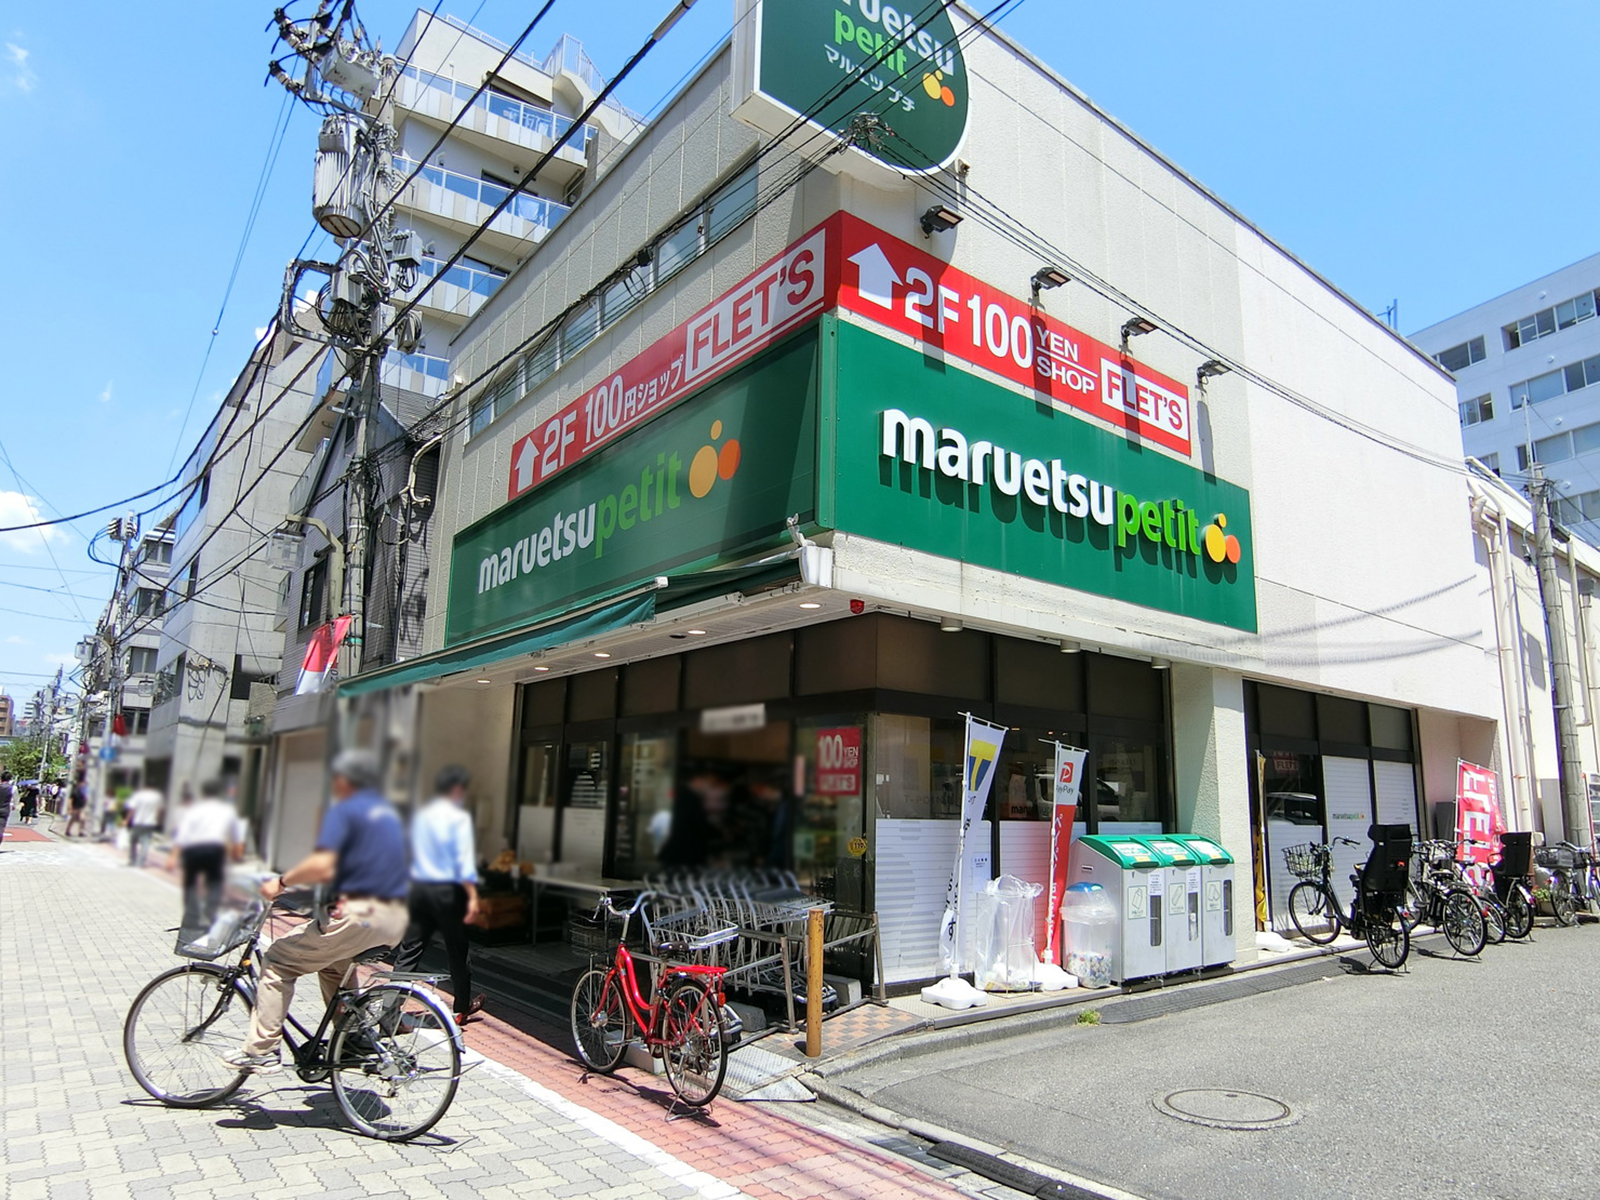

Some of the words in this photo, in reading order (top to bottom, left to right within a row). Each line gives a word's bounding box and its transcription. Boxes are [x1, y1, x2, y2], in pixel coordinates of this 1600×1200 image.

[834, 9, 907, 79] petit
[842, 0, 954, 76] uetsu
[904, 266, 959, 334] 2F
[967, 294, 1034, 369] 100
[1036, 325, 1079, 363] YEN
[541, 410, 578, 479] 2F
[693, 249, 815, 369] FLET'S
[1036, 356, 1096, 395] SHOP
[1106, 368, 1183, 431] FLET'S
[818, 734, 843, 769] 100
[843, 746, 859, 757] YEN
